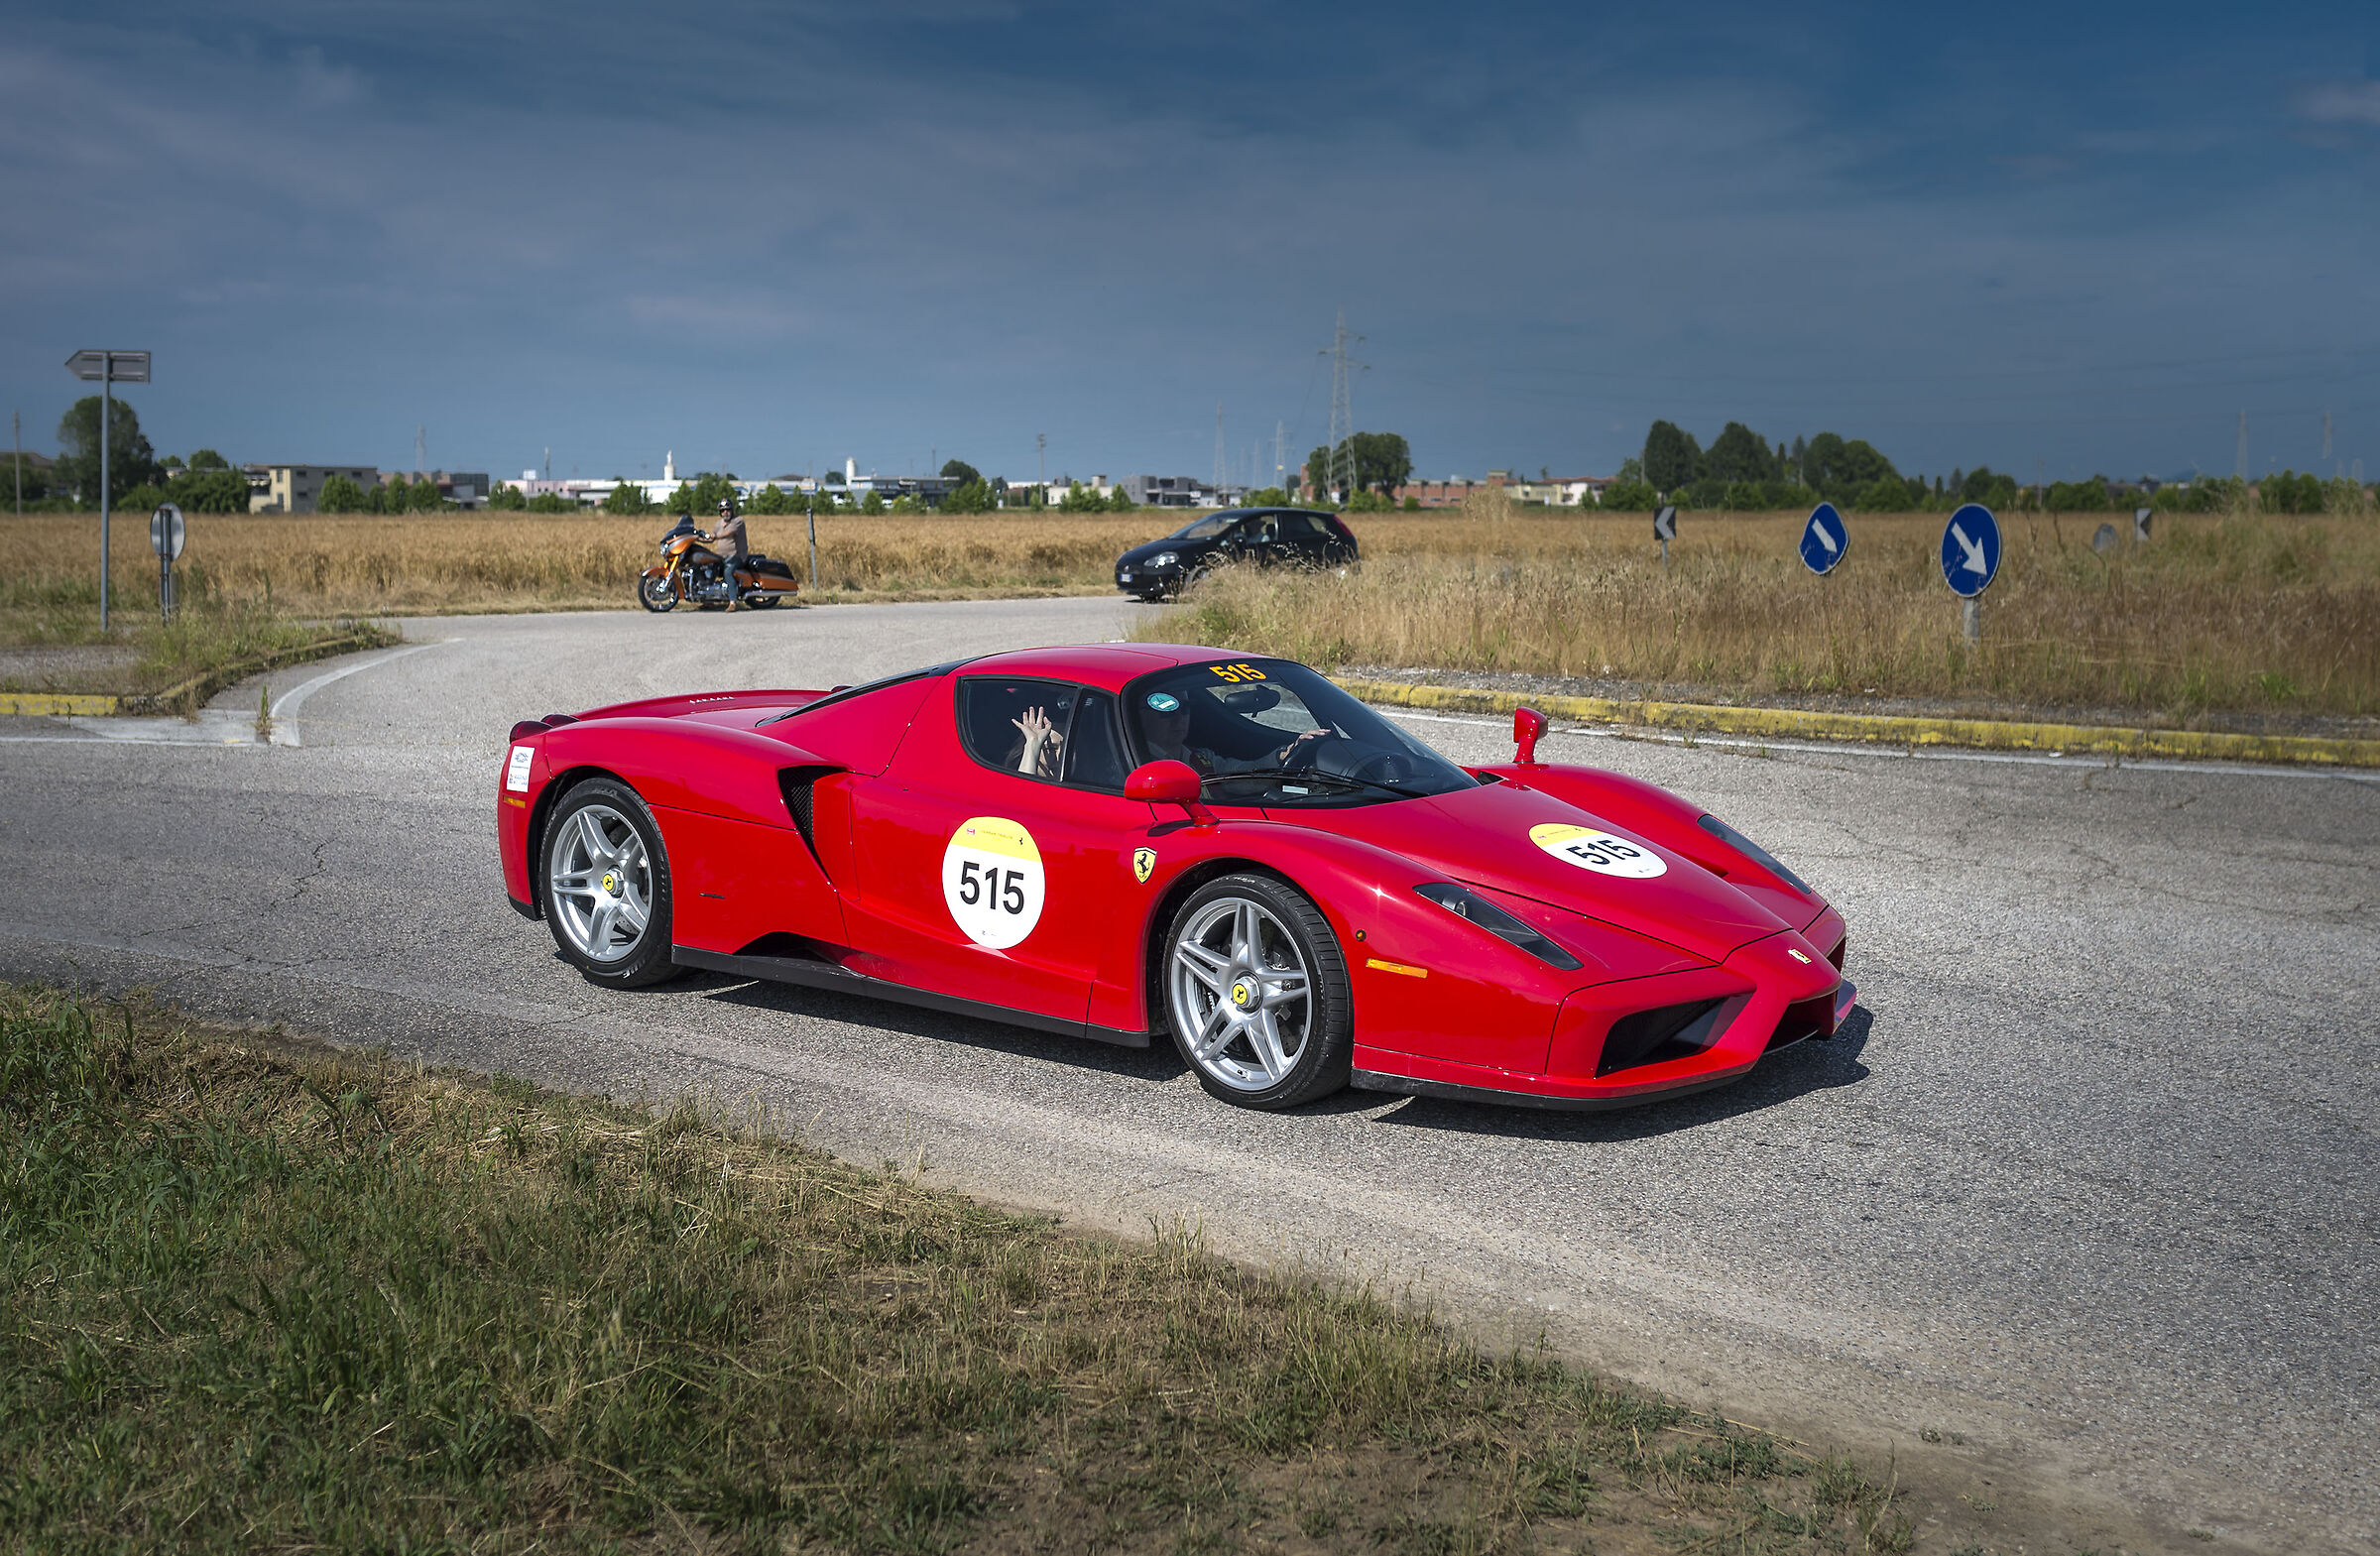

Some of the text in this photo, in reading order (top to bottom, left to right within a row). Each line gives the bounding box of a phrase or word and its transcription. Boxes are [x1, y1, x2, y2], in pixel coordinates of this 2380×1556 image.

[1209, 663, 1267, 683] 515
[1566, 839, 1641, 866] 515
[959, 860, 1024, 915] 515
